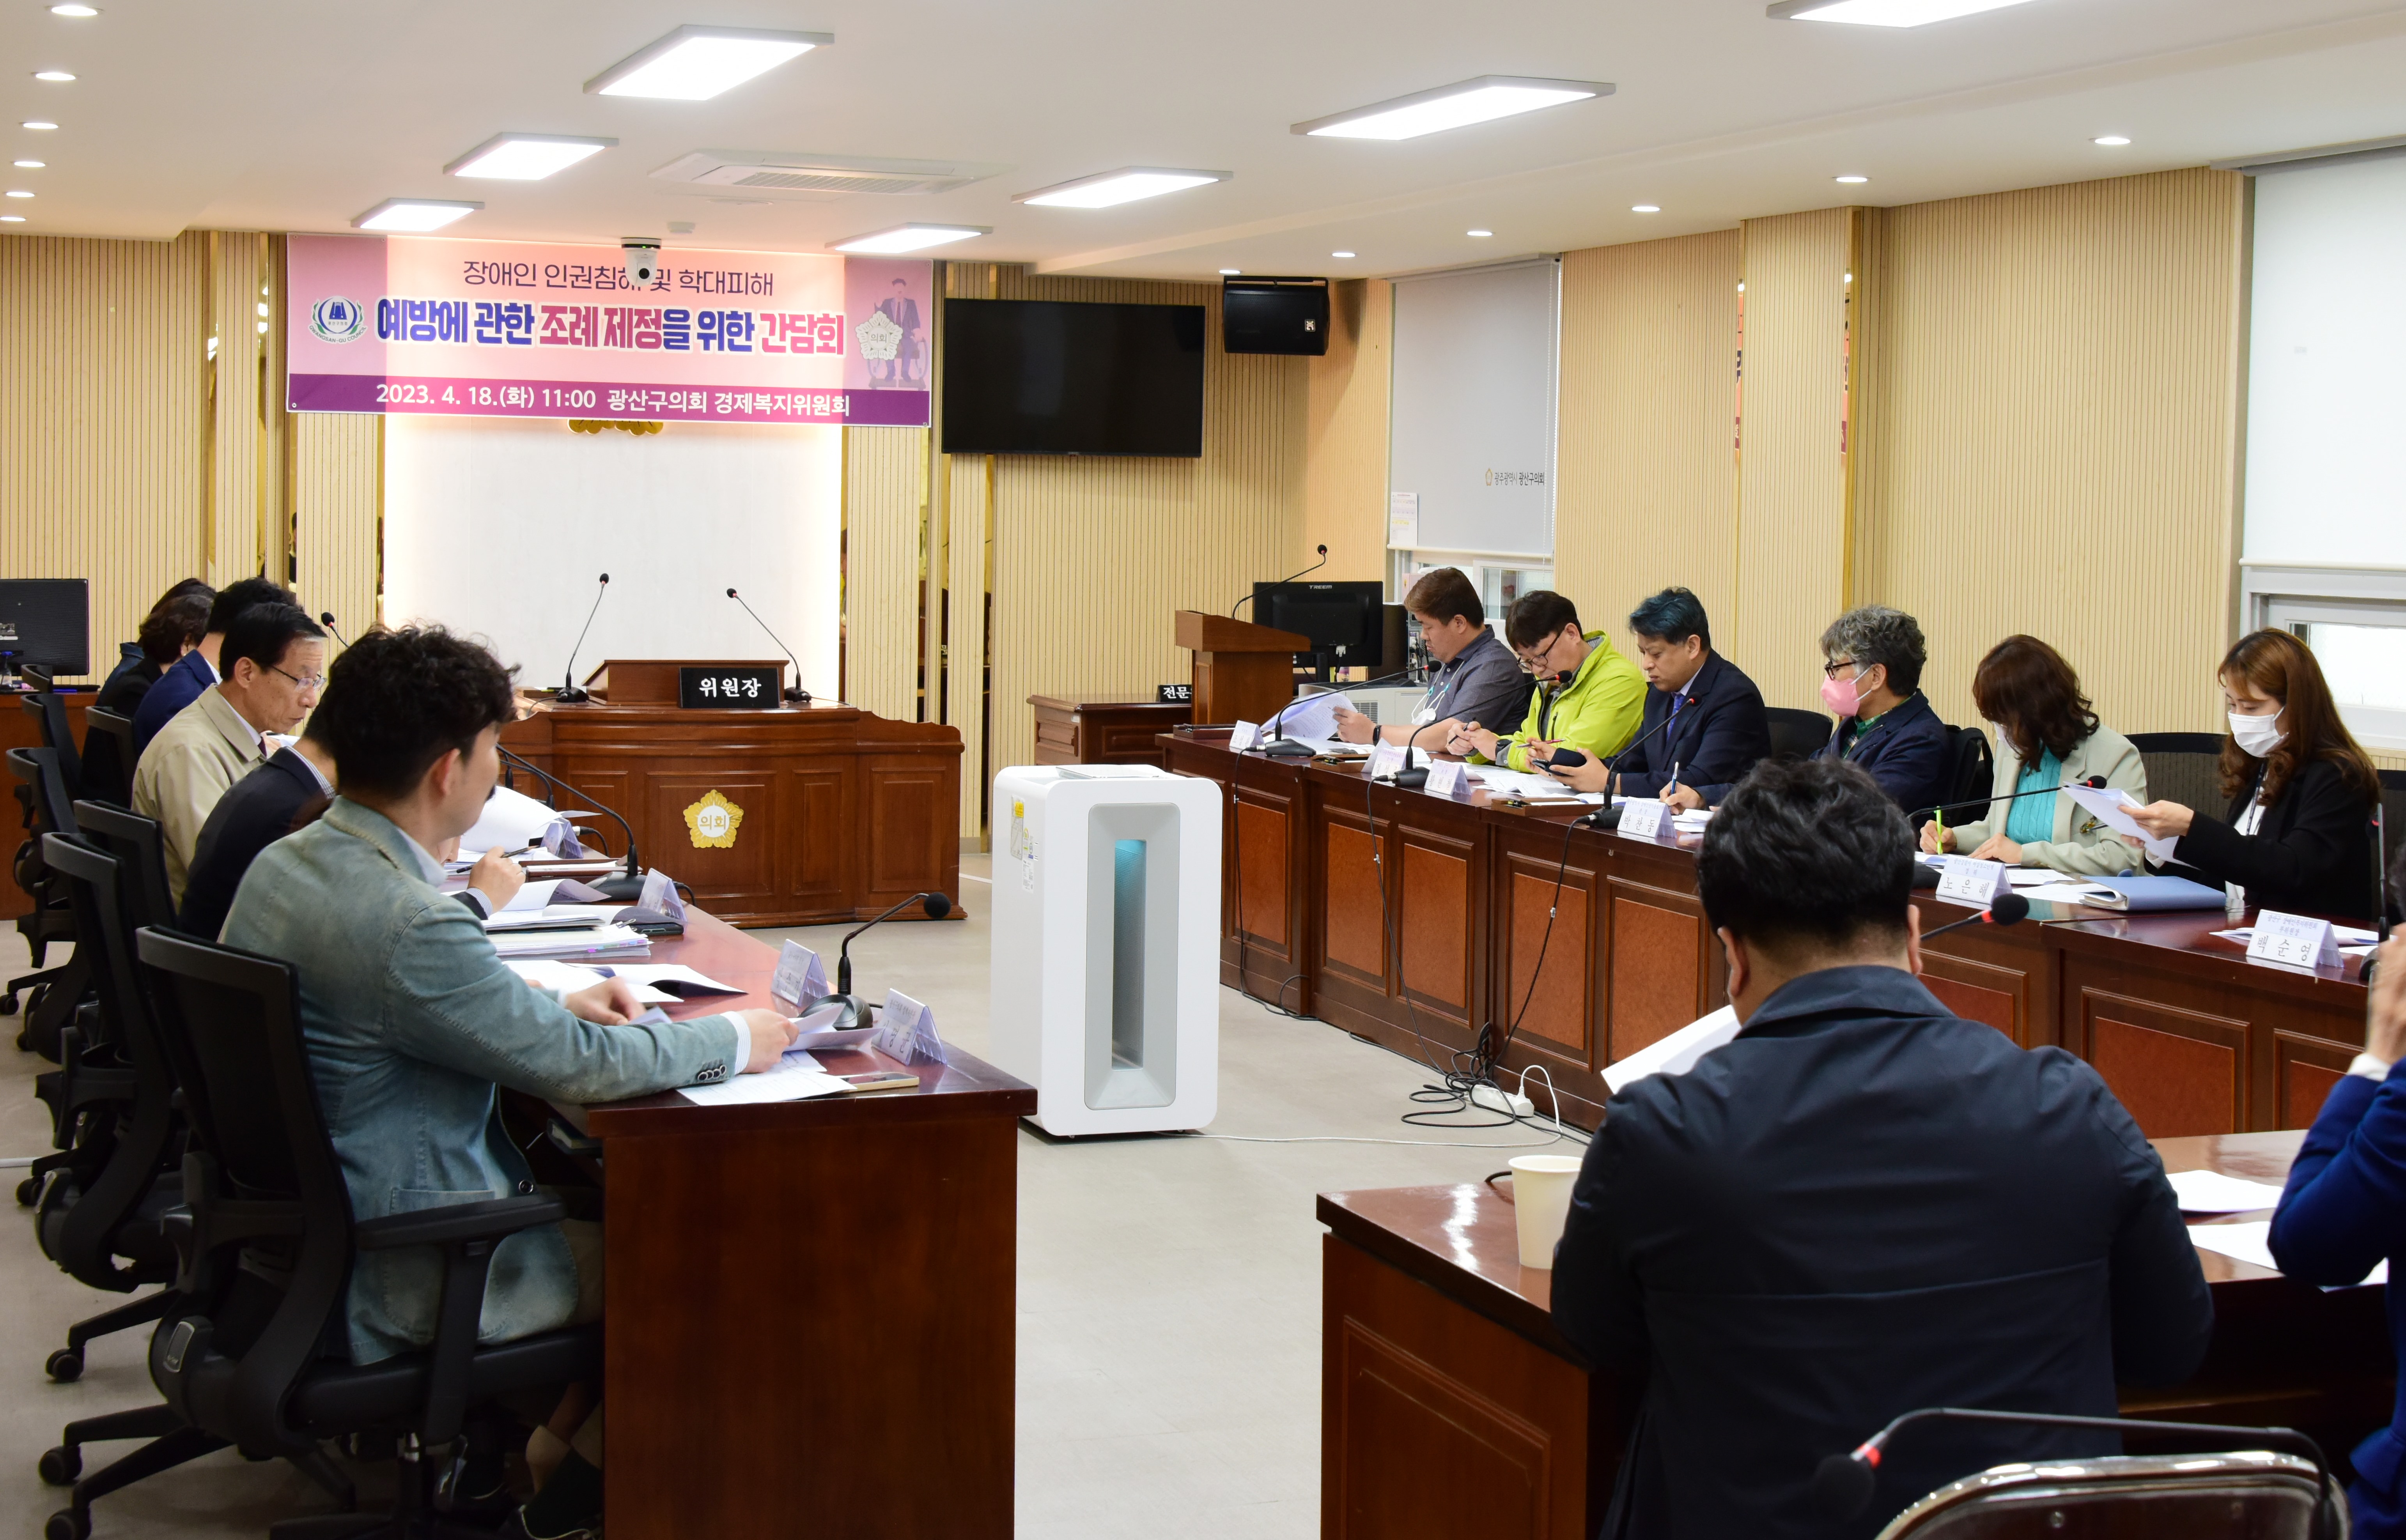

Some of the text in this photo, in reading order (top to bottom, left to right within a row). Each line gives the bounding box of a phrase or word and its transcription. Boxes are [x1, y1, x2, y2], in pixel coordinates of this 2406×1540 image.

[464, 261, 537, 287] 장애인
[650, 269, 671, 292] 및
[679, 269, 773, 296] 학대피해
[347, 326, 367, 342] COUNCIL
[377, 298, 843, 355] 예방에 관한 조례 제정을 위한 간담회
[870, 333, 887, 343] 의회
[376, 384, 849, 416] 2023. 4. 18.(화) 11:00 광산구의회 경제복지위원회
[1494, 472, 1544, 486] 광주광역시 광산구의회
[699, 678, 762, 698] 위원장
[1163, 686, 1192, 699] 전문
[700, 815, 726, 830] 의회
